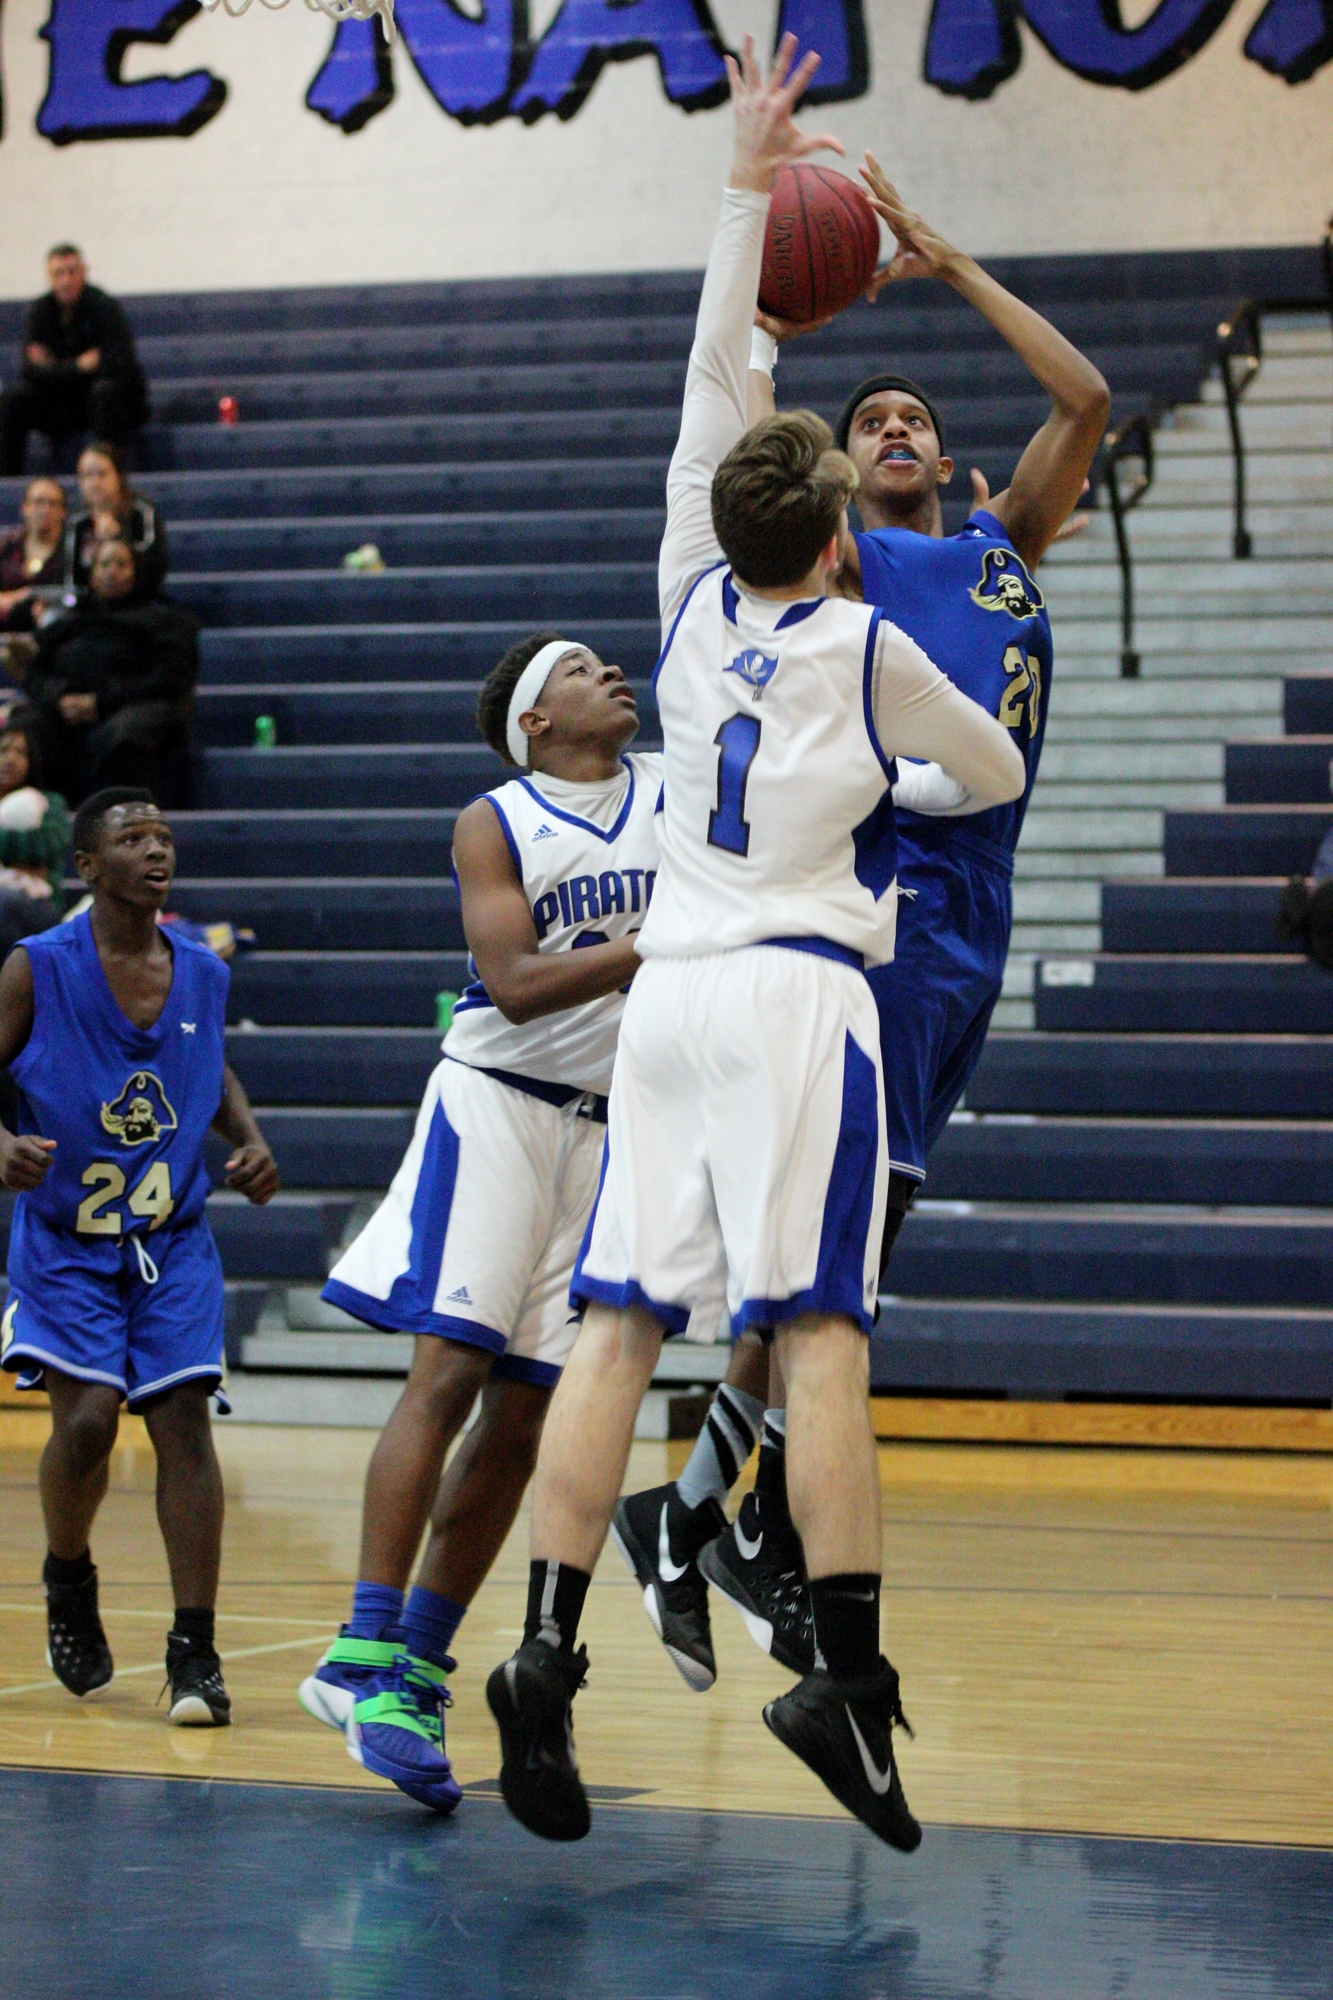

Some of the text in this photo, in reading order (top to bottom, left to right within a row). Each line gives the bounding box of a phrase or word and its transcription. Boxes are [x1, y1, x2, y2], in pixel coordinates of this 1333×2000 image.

[706, 711, 762, 859] 1
[531, 832, 559, 843] adidas
[75, 1160, 176, 1236] 24
